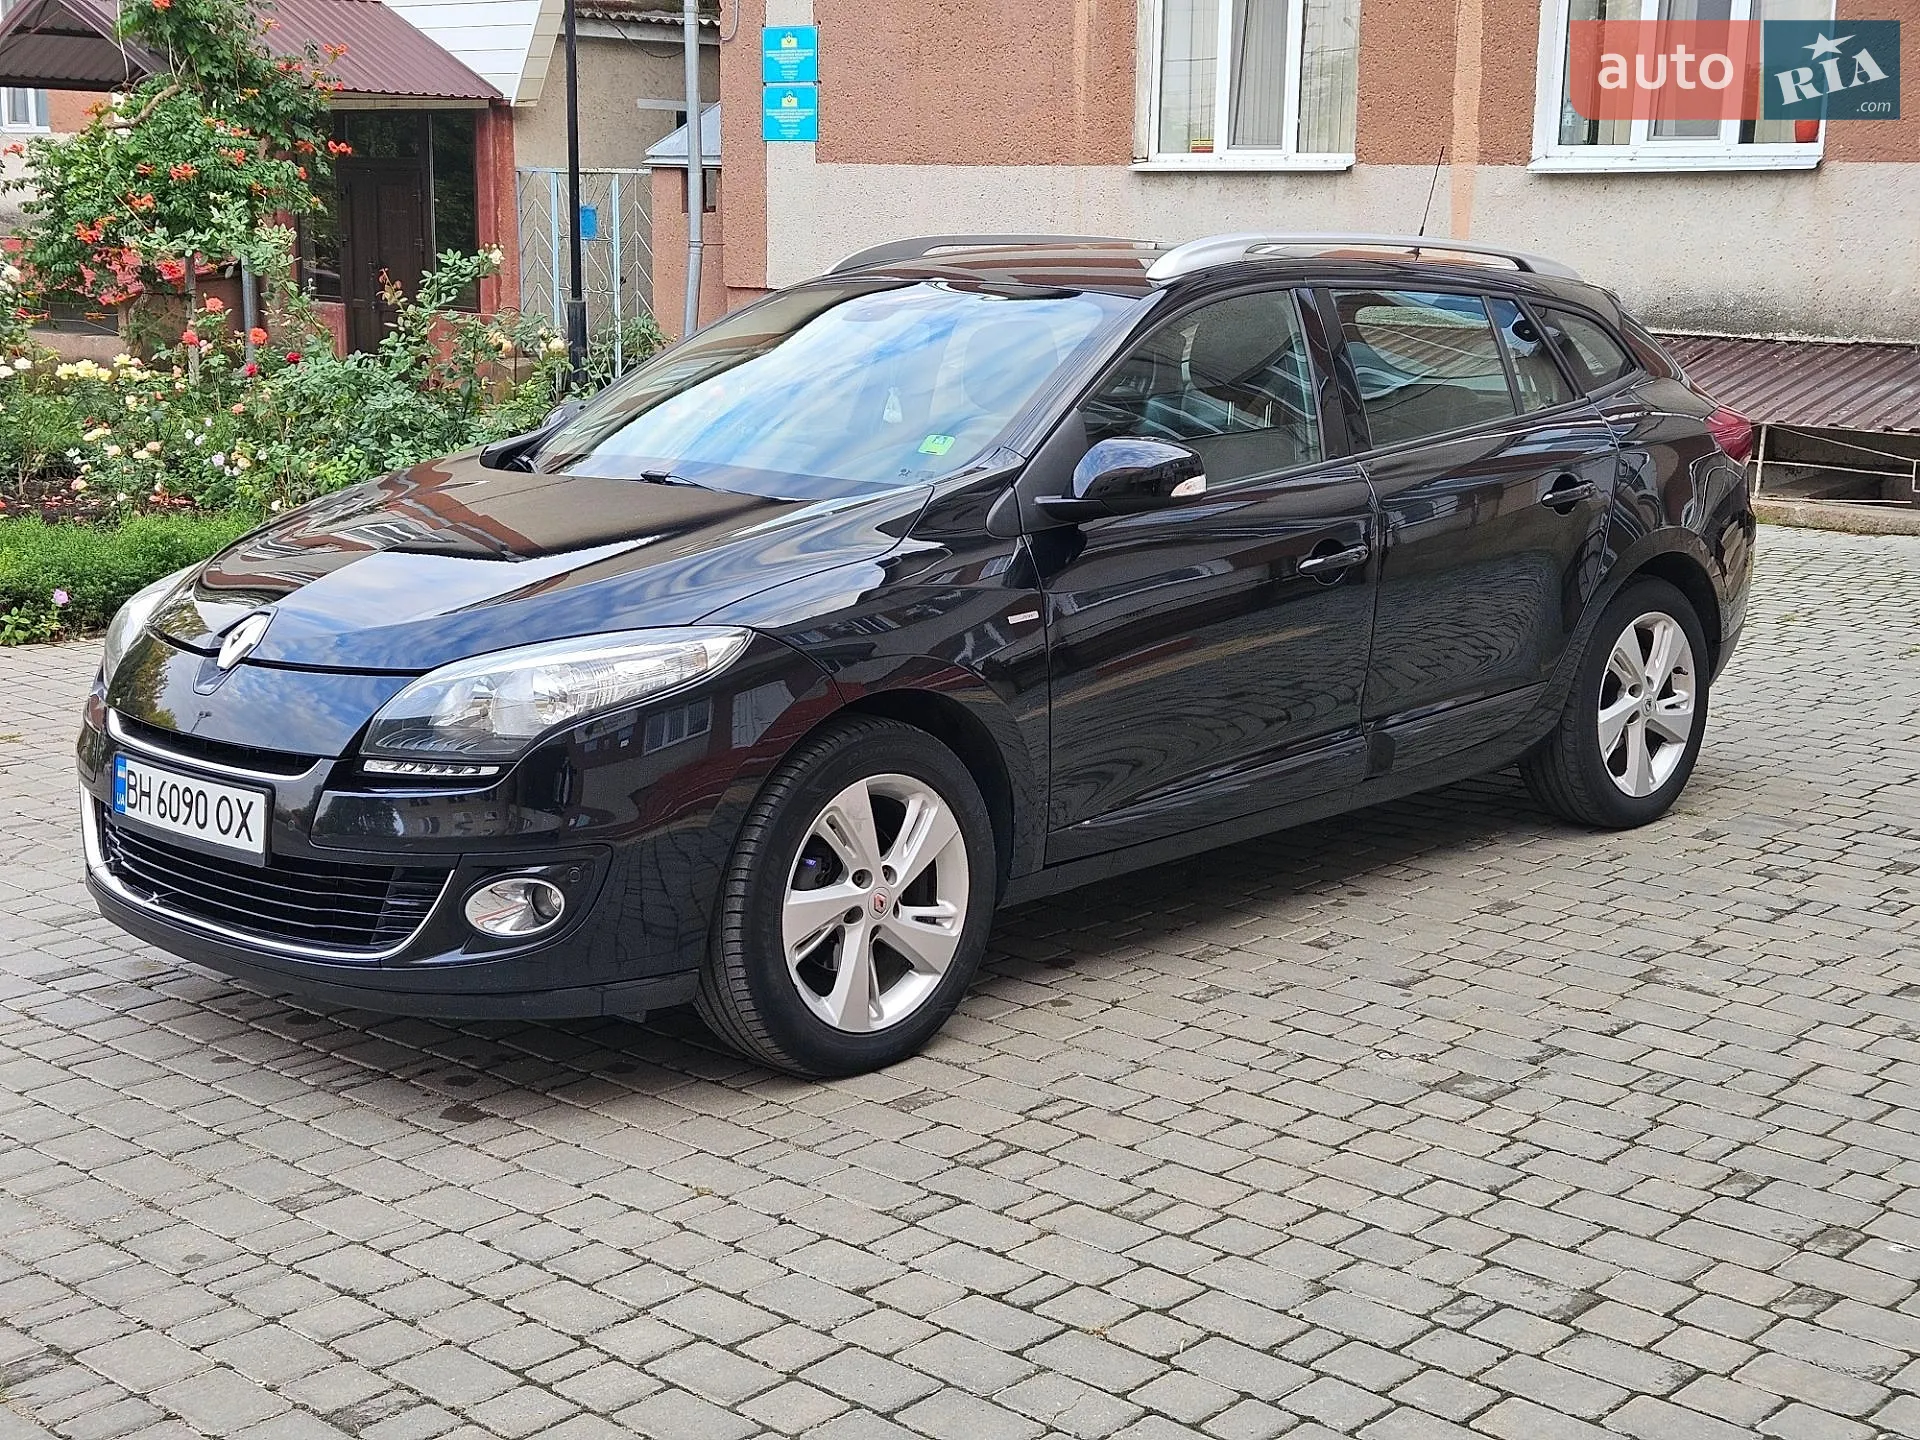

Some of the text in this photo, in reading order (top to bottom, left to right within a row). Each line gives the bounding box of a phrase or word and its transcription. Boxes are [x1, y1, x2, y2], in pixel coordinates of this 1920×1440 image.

[127, 769, 254, 842] BH 6090 OX
